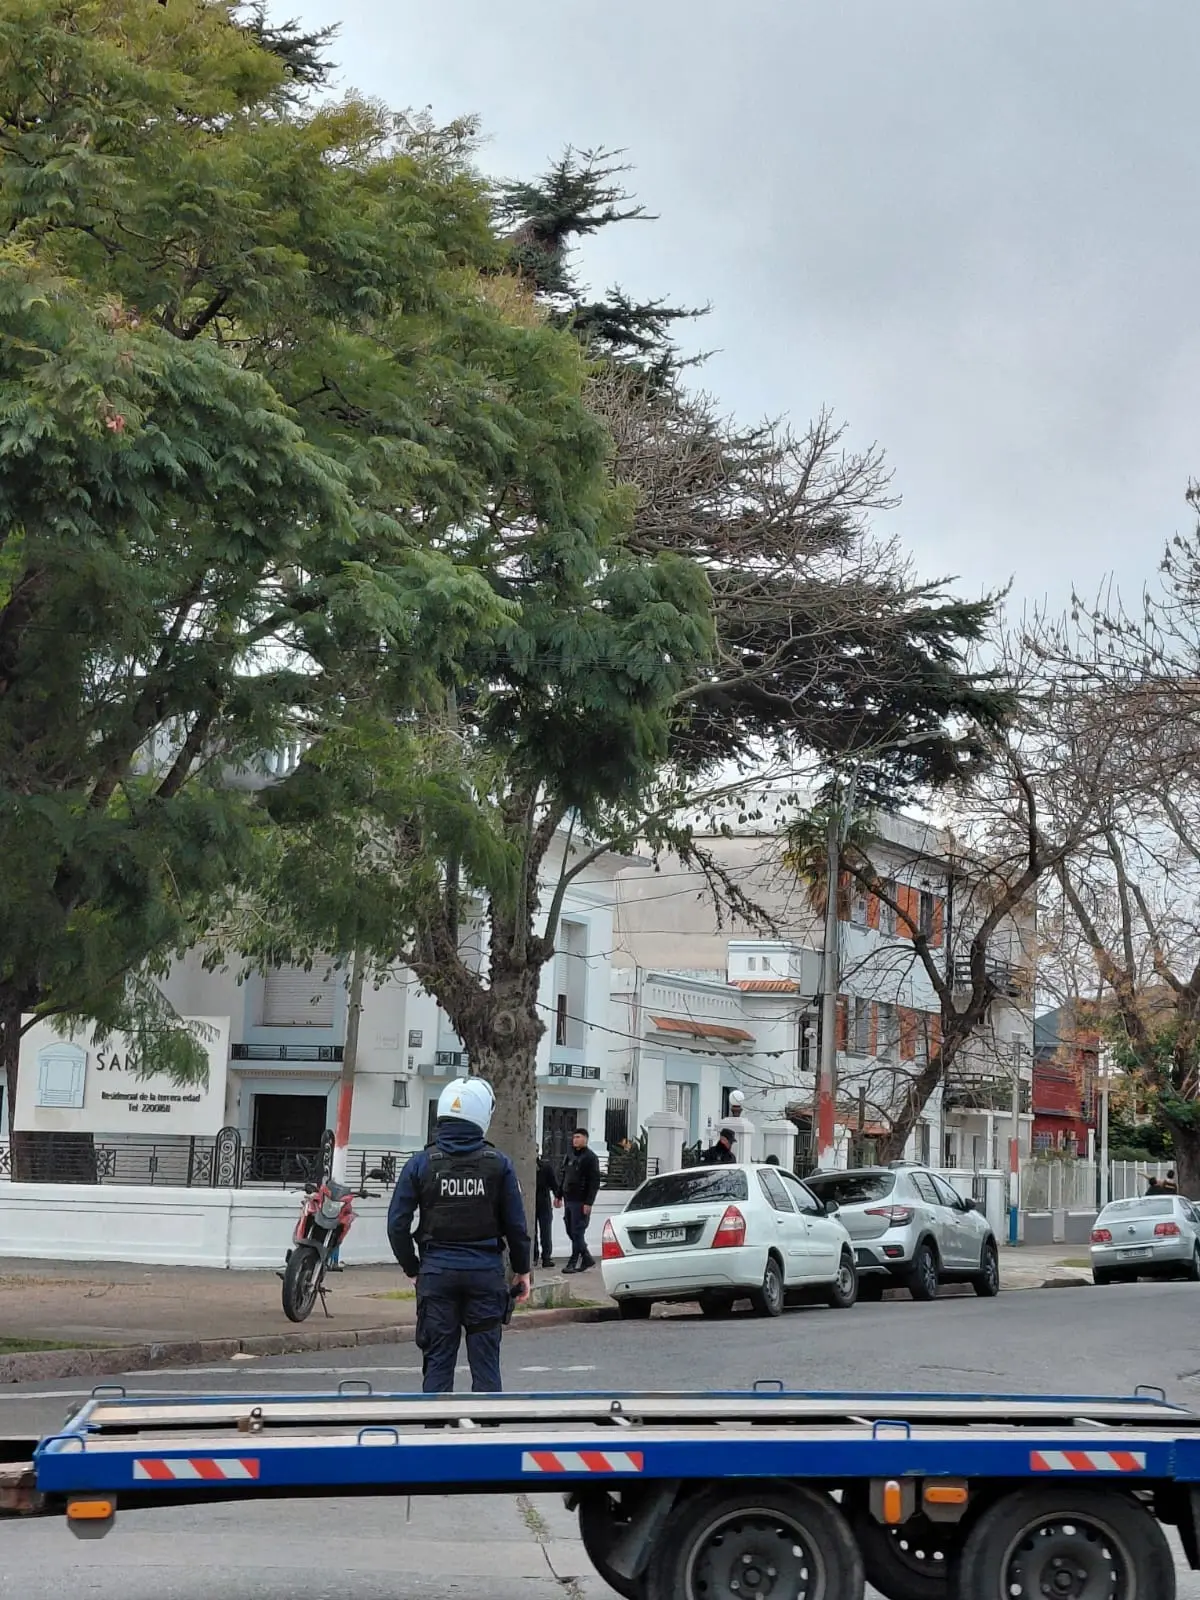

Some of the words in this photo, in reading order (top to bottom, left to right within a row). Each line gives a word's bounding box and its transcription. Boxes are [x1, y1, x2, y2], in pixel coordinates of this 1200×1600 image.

[139, 1092, 149, 1100] de
[150, 1092, 157, 1100] la
[182, 1094, 201, 1102] edad
[440, 1179, 485, 1196] POLICIA
